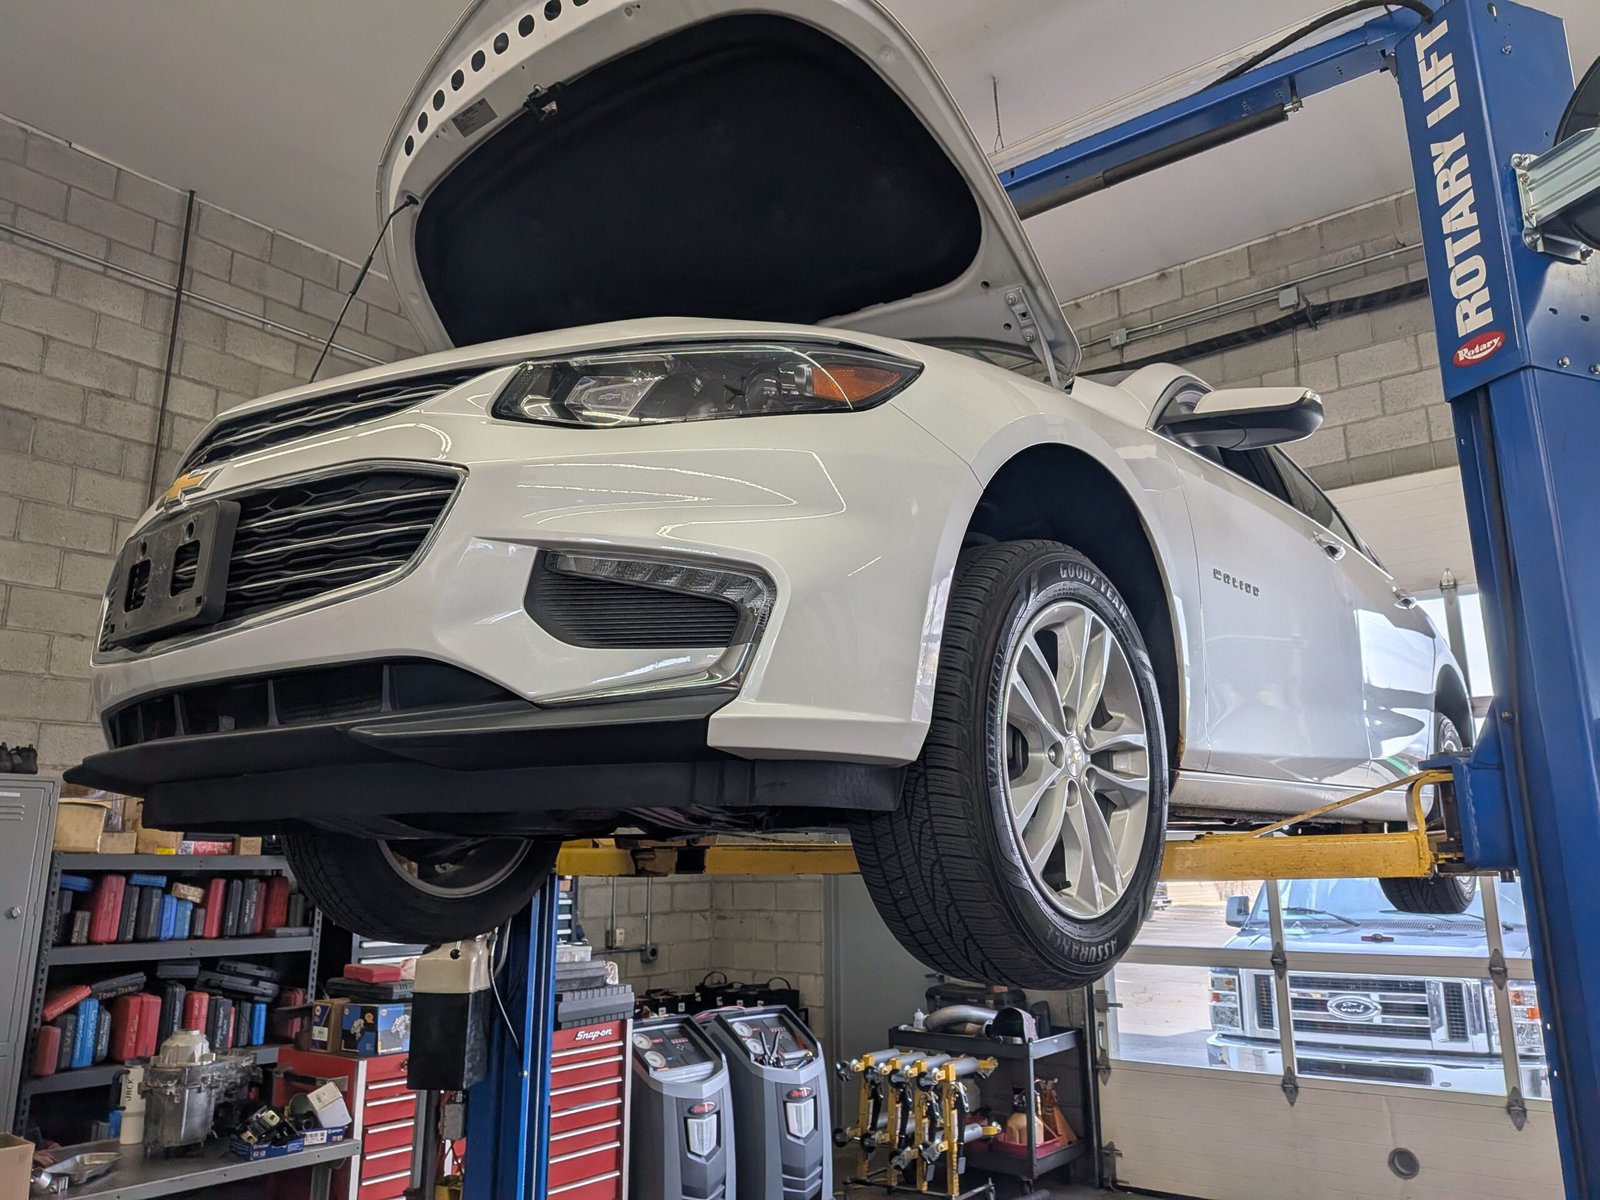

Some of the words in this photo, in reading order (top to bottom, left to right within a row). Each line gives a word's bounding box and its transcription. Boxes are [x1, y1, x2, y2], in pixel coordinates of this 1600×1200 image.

[1414, 20, 1460, 128] LIFT
[1430, 132, 1493, 338] ROTARY
[1457, 335, 1501, 363] Rotary
[1060, 563, 1128, 620] GOODYEAR
[575, 1029, 613, 1041] Snap-on
